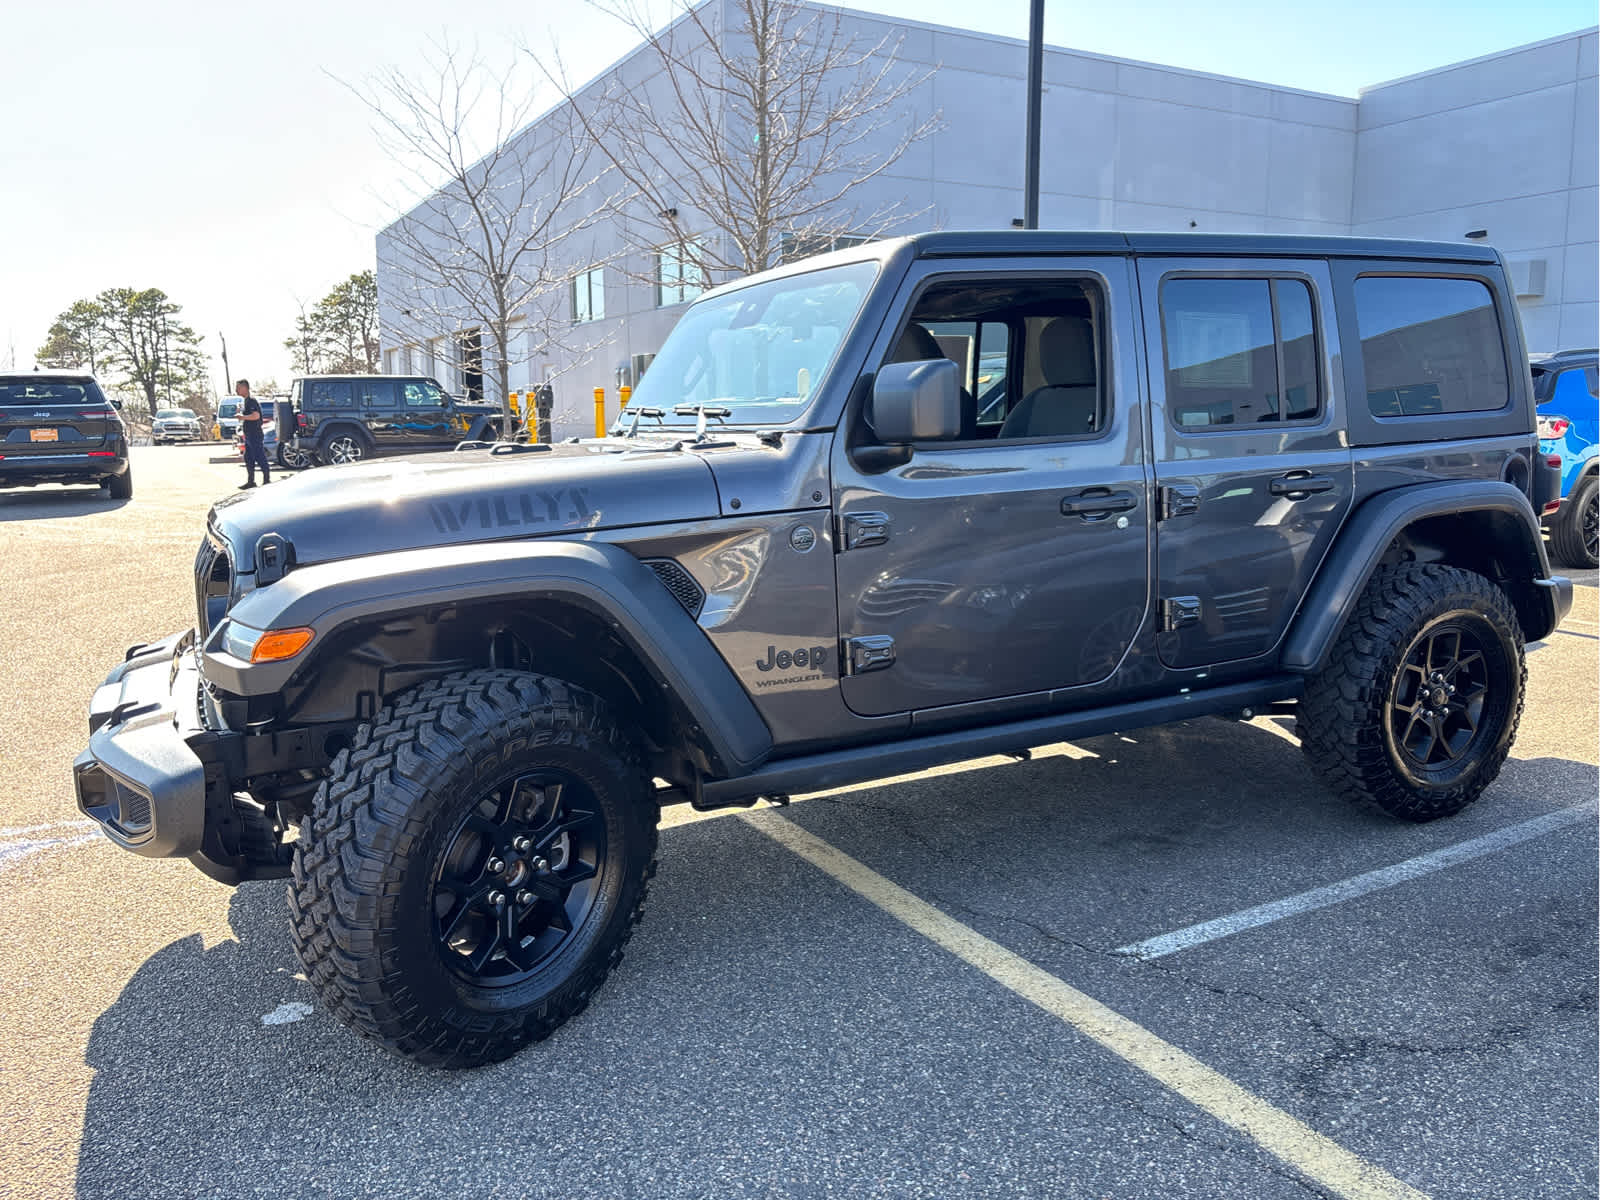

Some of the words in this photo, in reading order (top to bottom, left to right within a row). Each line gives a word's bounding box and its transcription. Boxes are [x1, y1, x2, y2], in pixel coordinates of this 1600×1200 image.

[428, 487, 590, 533] WILLYS
[756, 645, 828, 672] Jeep
[756, 674, 821, 688] WRANGLER
